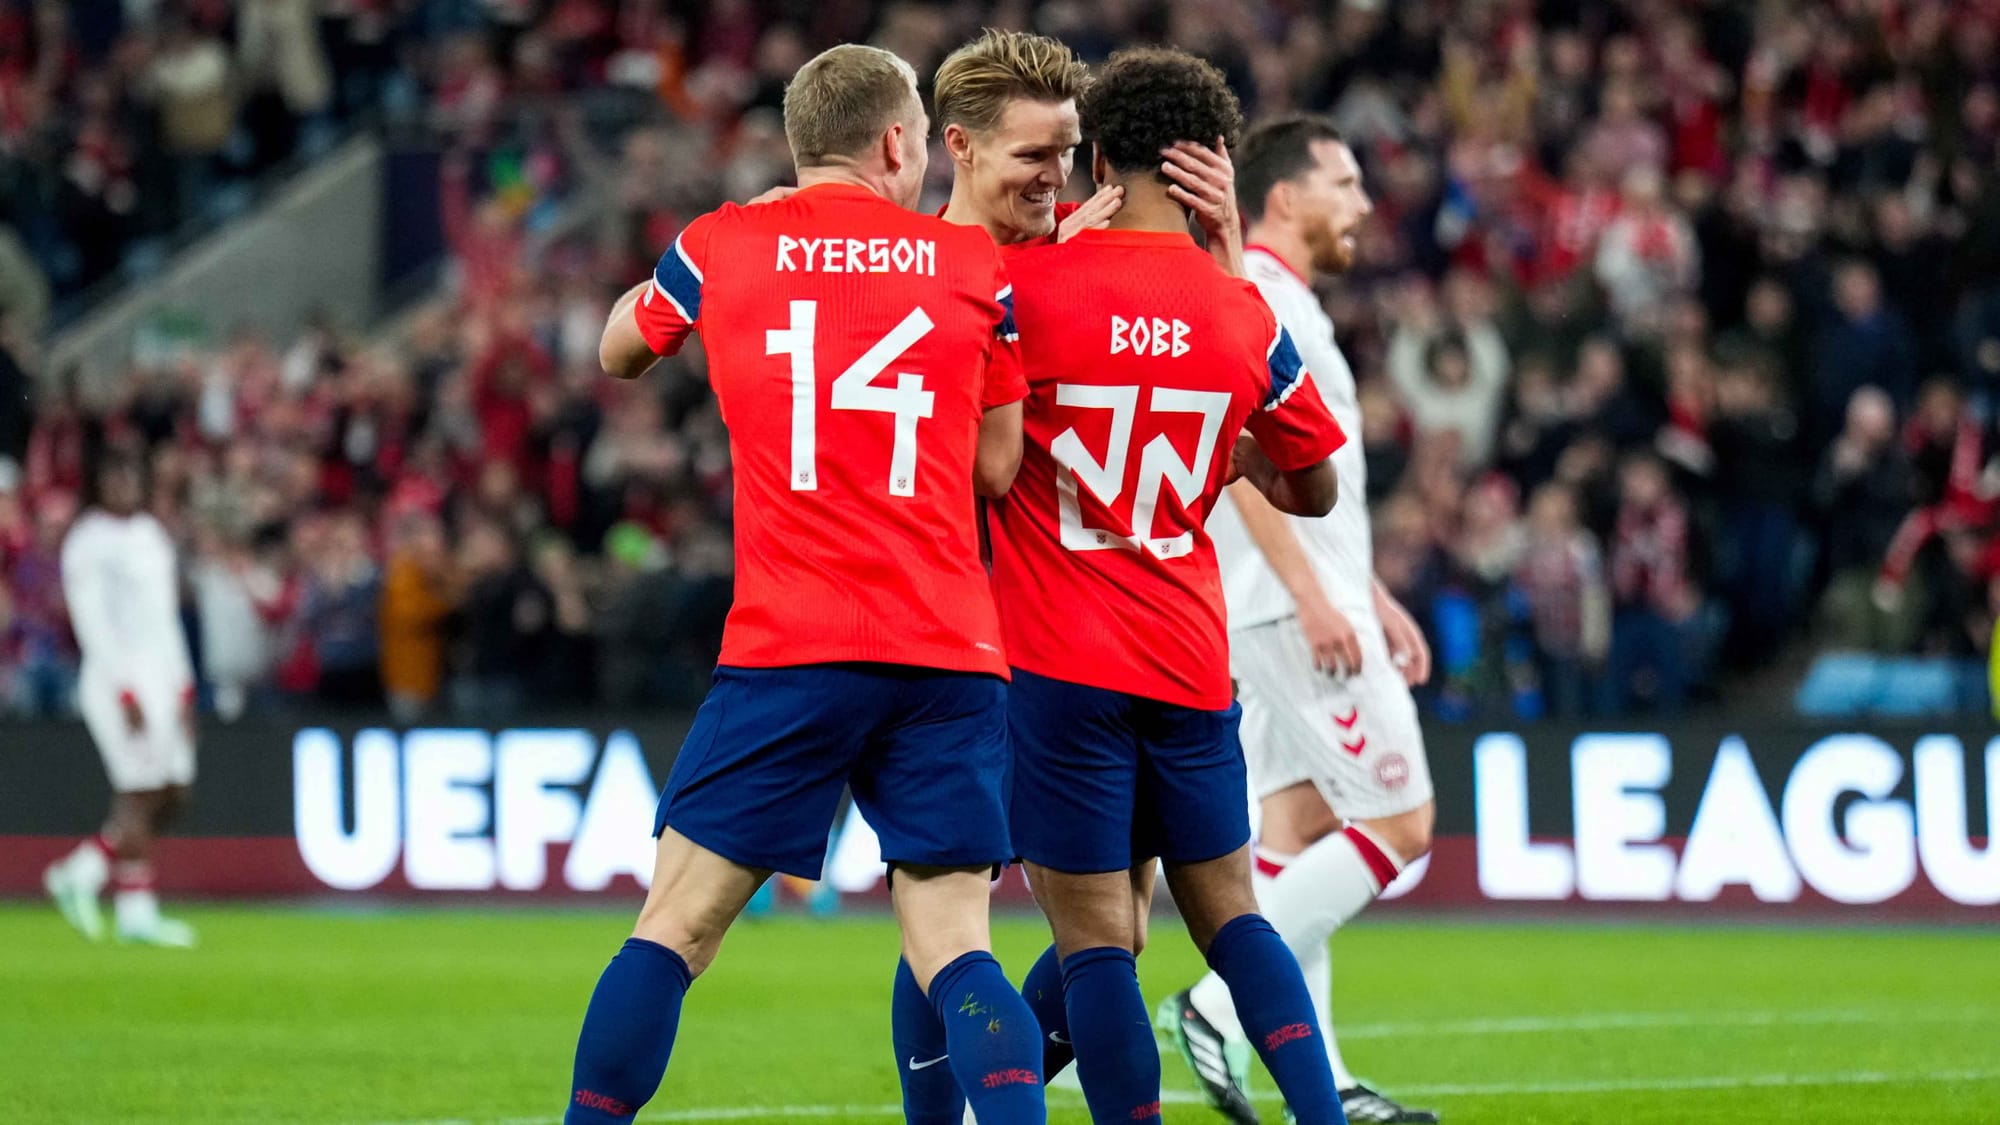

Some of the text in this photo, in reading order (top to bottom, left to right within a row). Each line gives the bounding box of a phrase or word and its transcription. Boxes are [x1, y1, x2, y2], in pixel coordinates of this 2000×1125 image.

[775, 234, 936, 277] RYERSON
[1110, 315, 1191, 358] BOBB
[765, 299, 935, 498] 14
[1050, 382, 1232, 561] 22
[293, 728, 658, 891] UEFA
